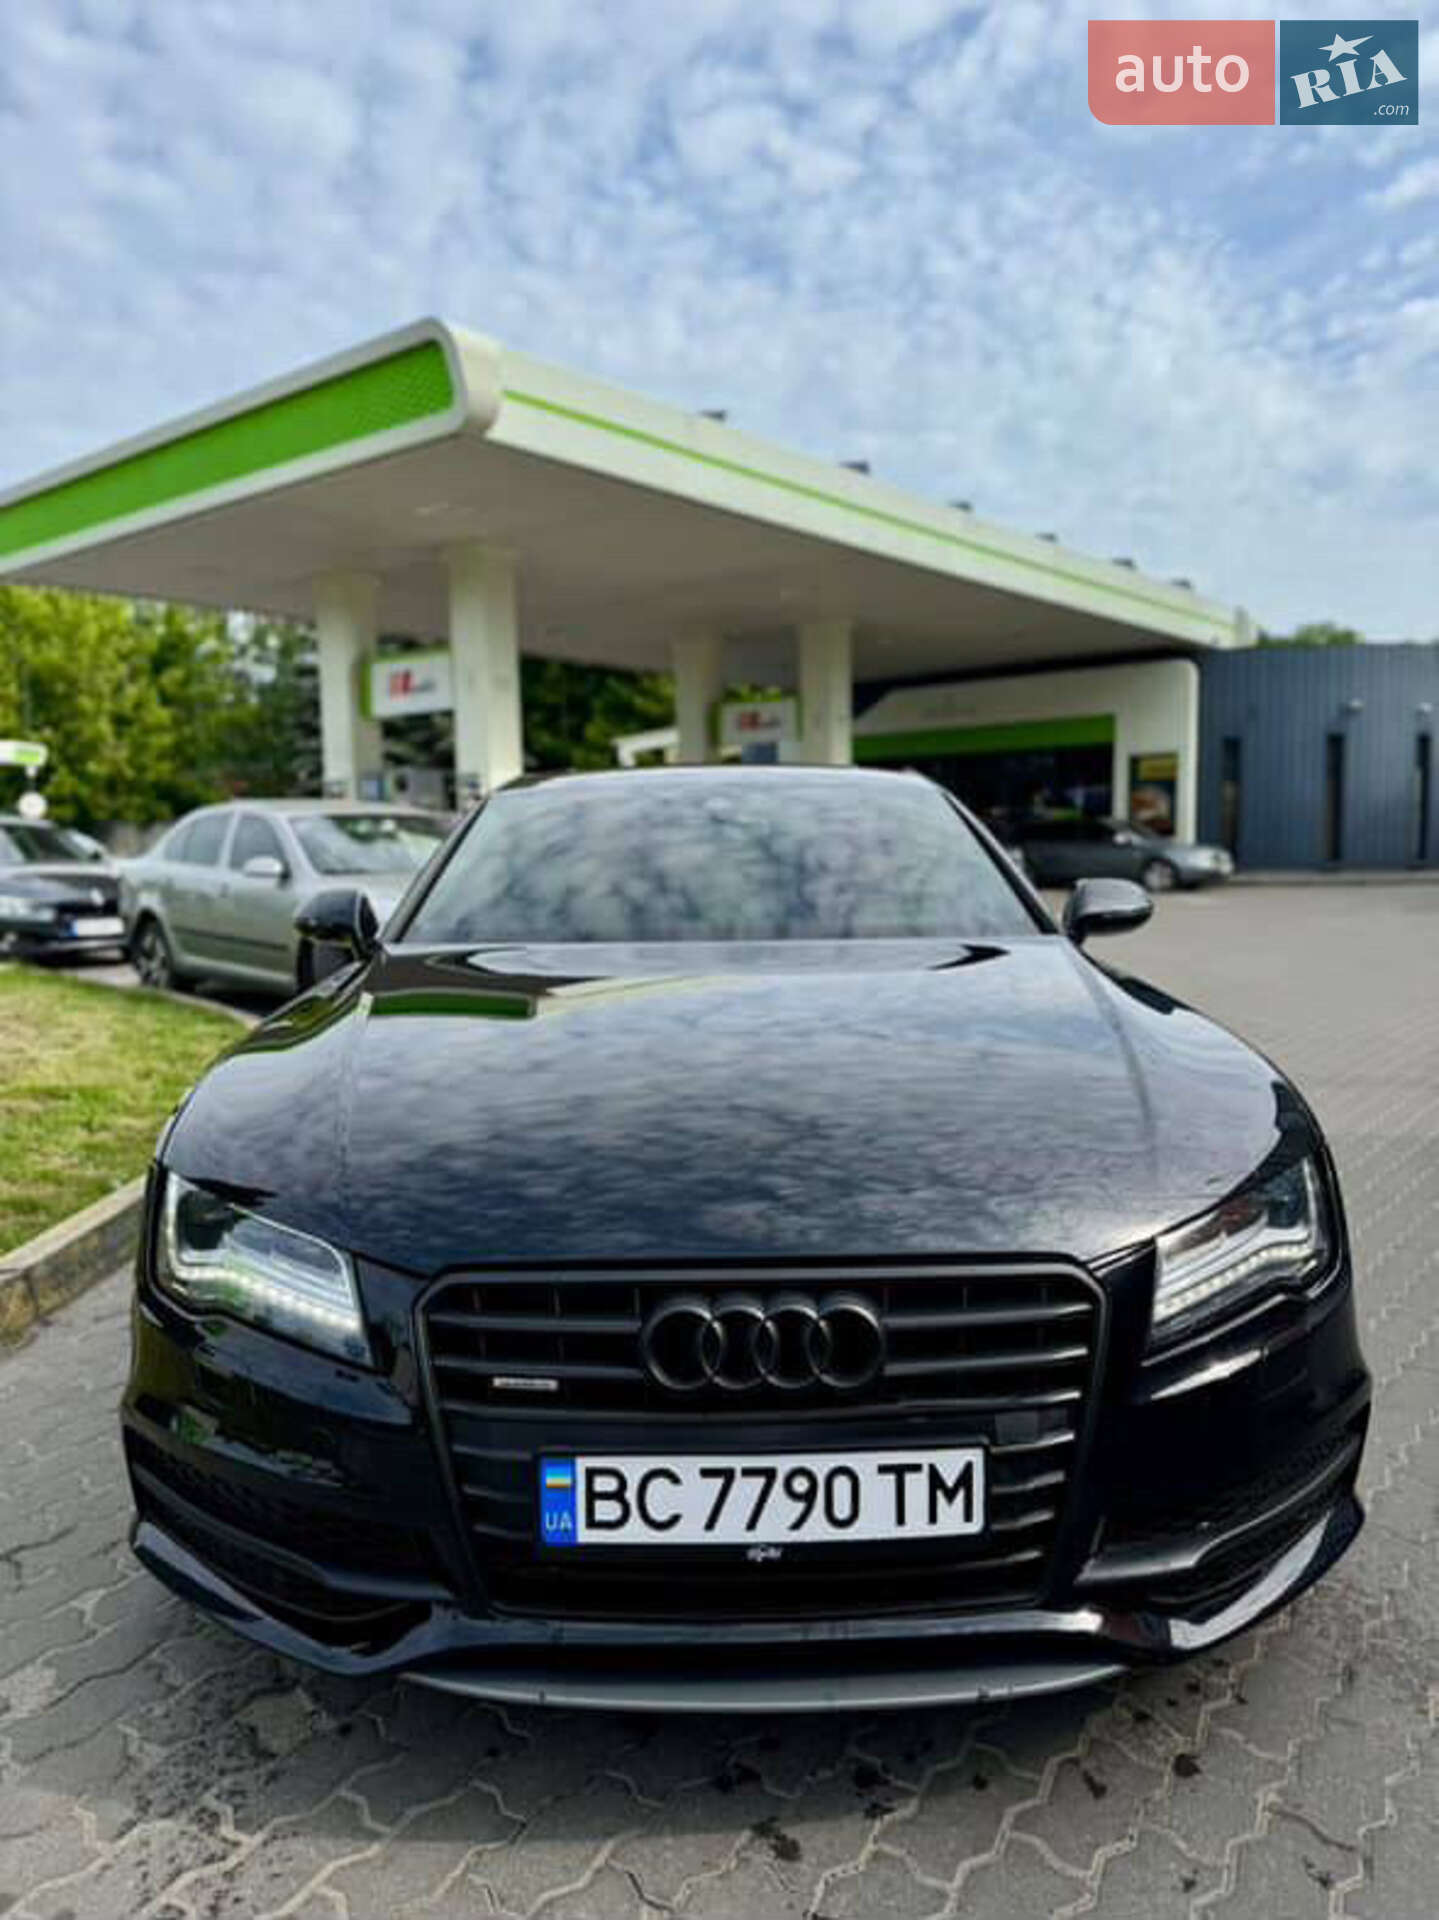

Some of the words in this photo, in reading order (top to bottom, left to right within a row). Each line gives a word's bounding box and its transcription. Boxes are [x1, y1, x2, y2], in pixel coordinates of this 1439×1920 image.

[584, 1466, 683, 1532] BC
[700, 1466, 860, 1532] 7790
[877, 1460, 975, 1527] TM
[545, 1511, 572, 1532] UA
